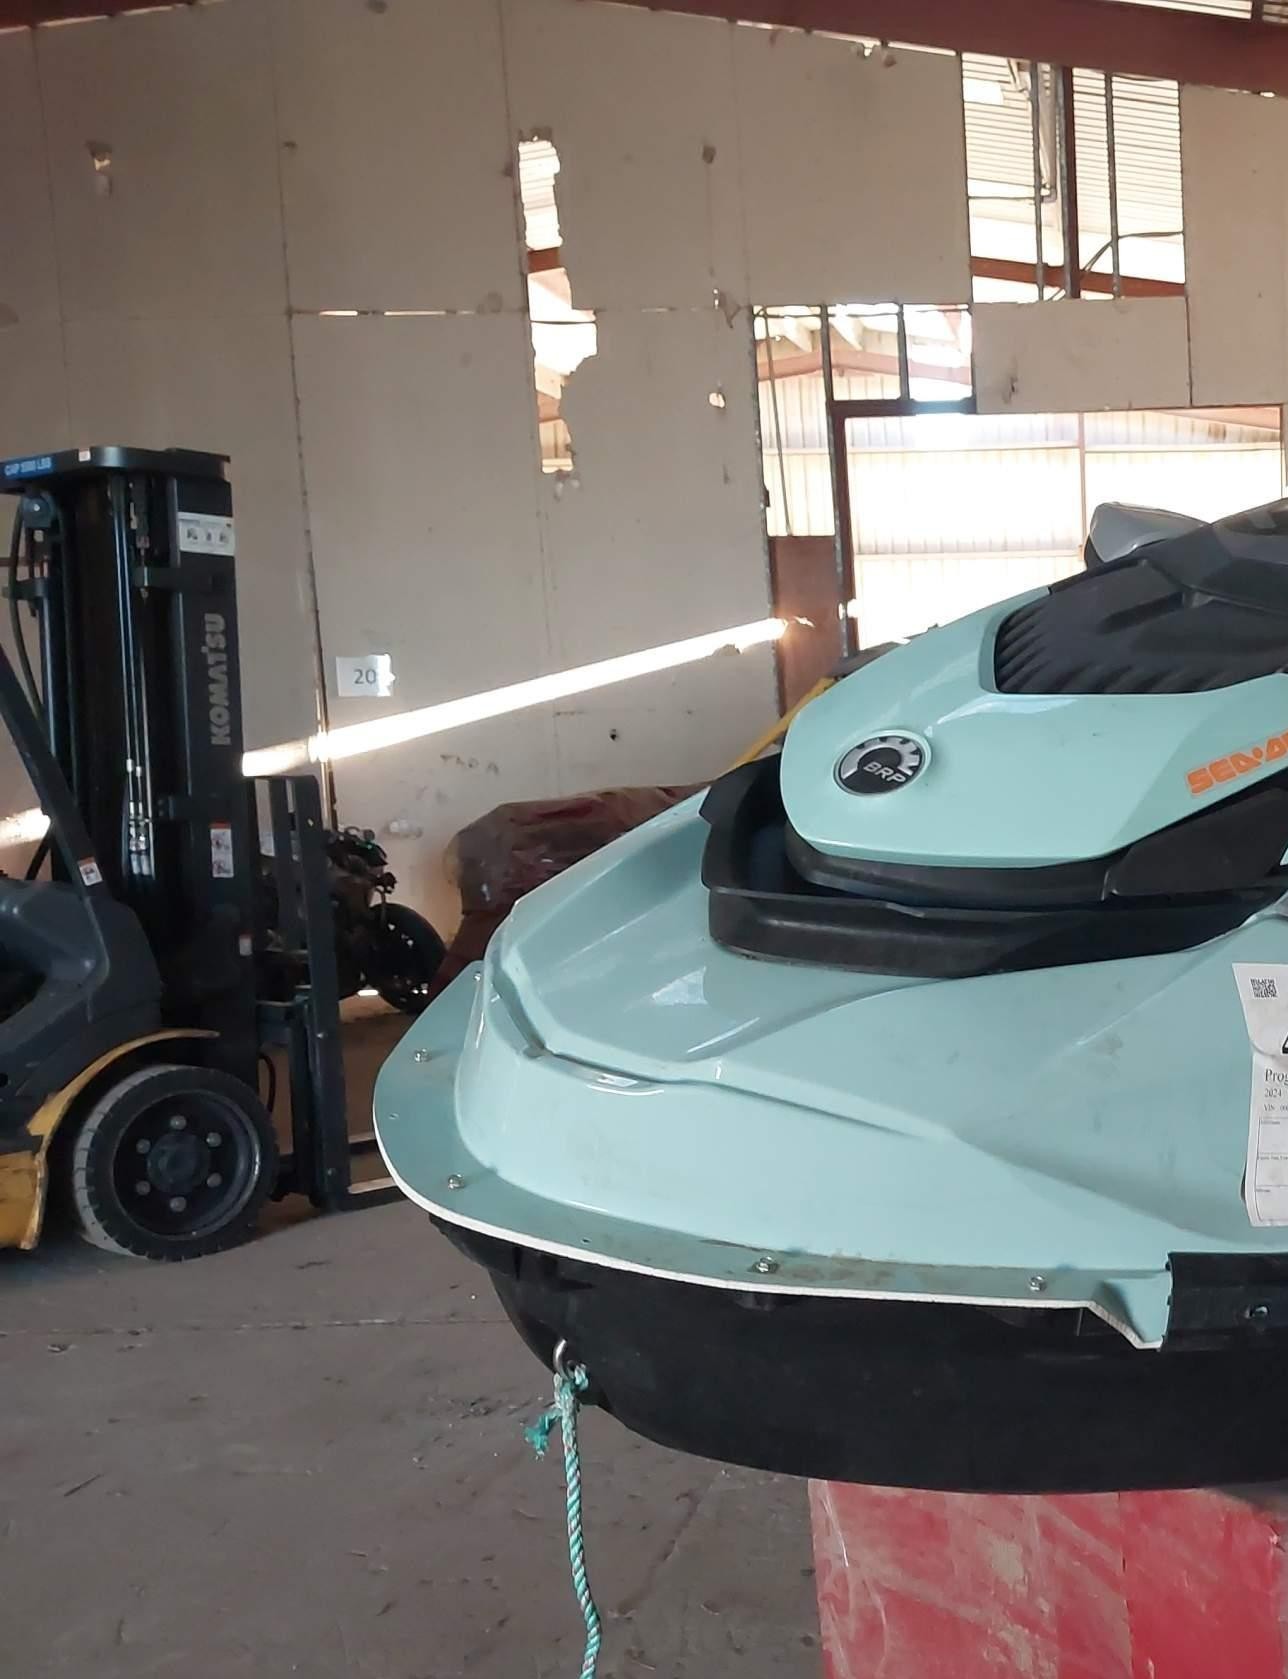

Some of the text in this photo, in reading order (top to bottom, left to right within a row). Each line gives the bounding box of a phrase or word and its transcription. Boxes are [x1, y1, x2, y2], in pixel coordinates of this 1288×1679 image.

[201, 613, 231, 745] KOMATSU
[354, 668, 377, 685] 20
[863, 761, 906, 782] BRP
[1264, 1088, 1282, 1098] 2024
